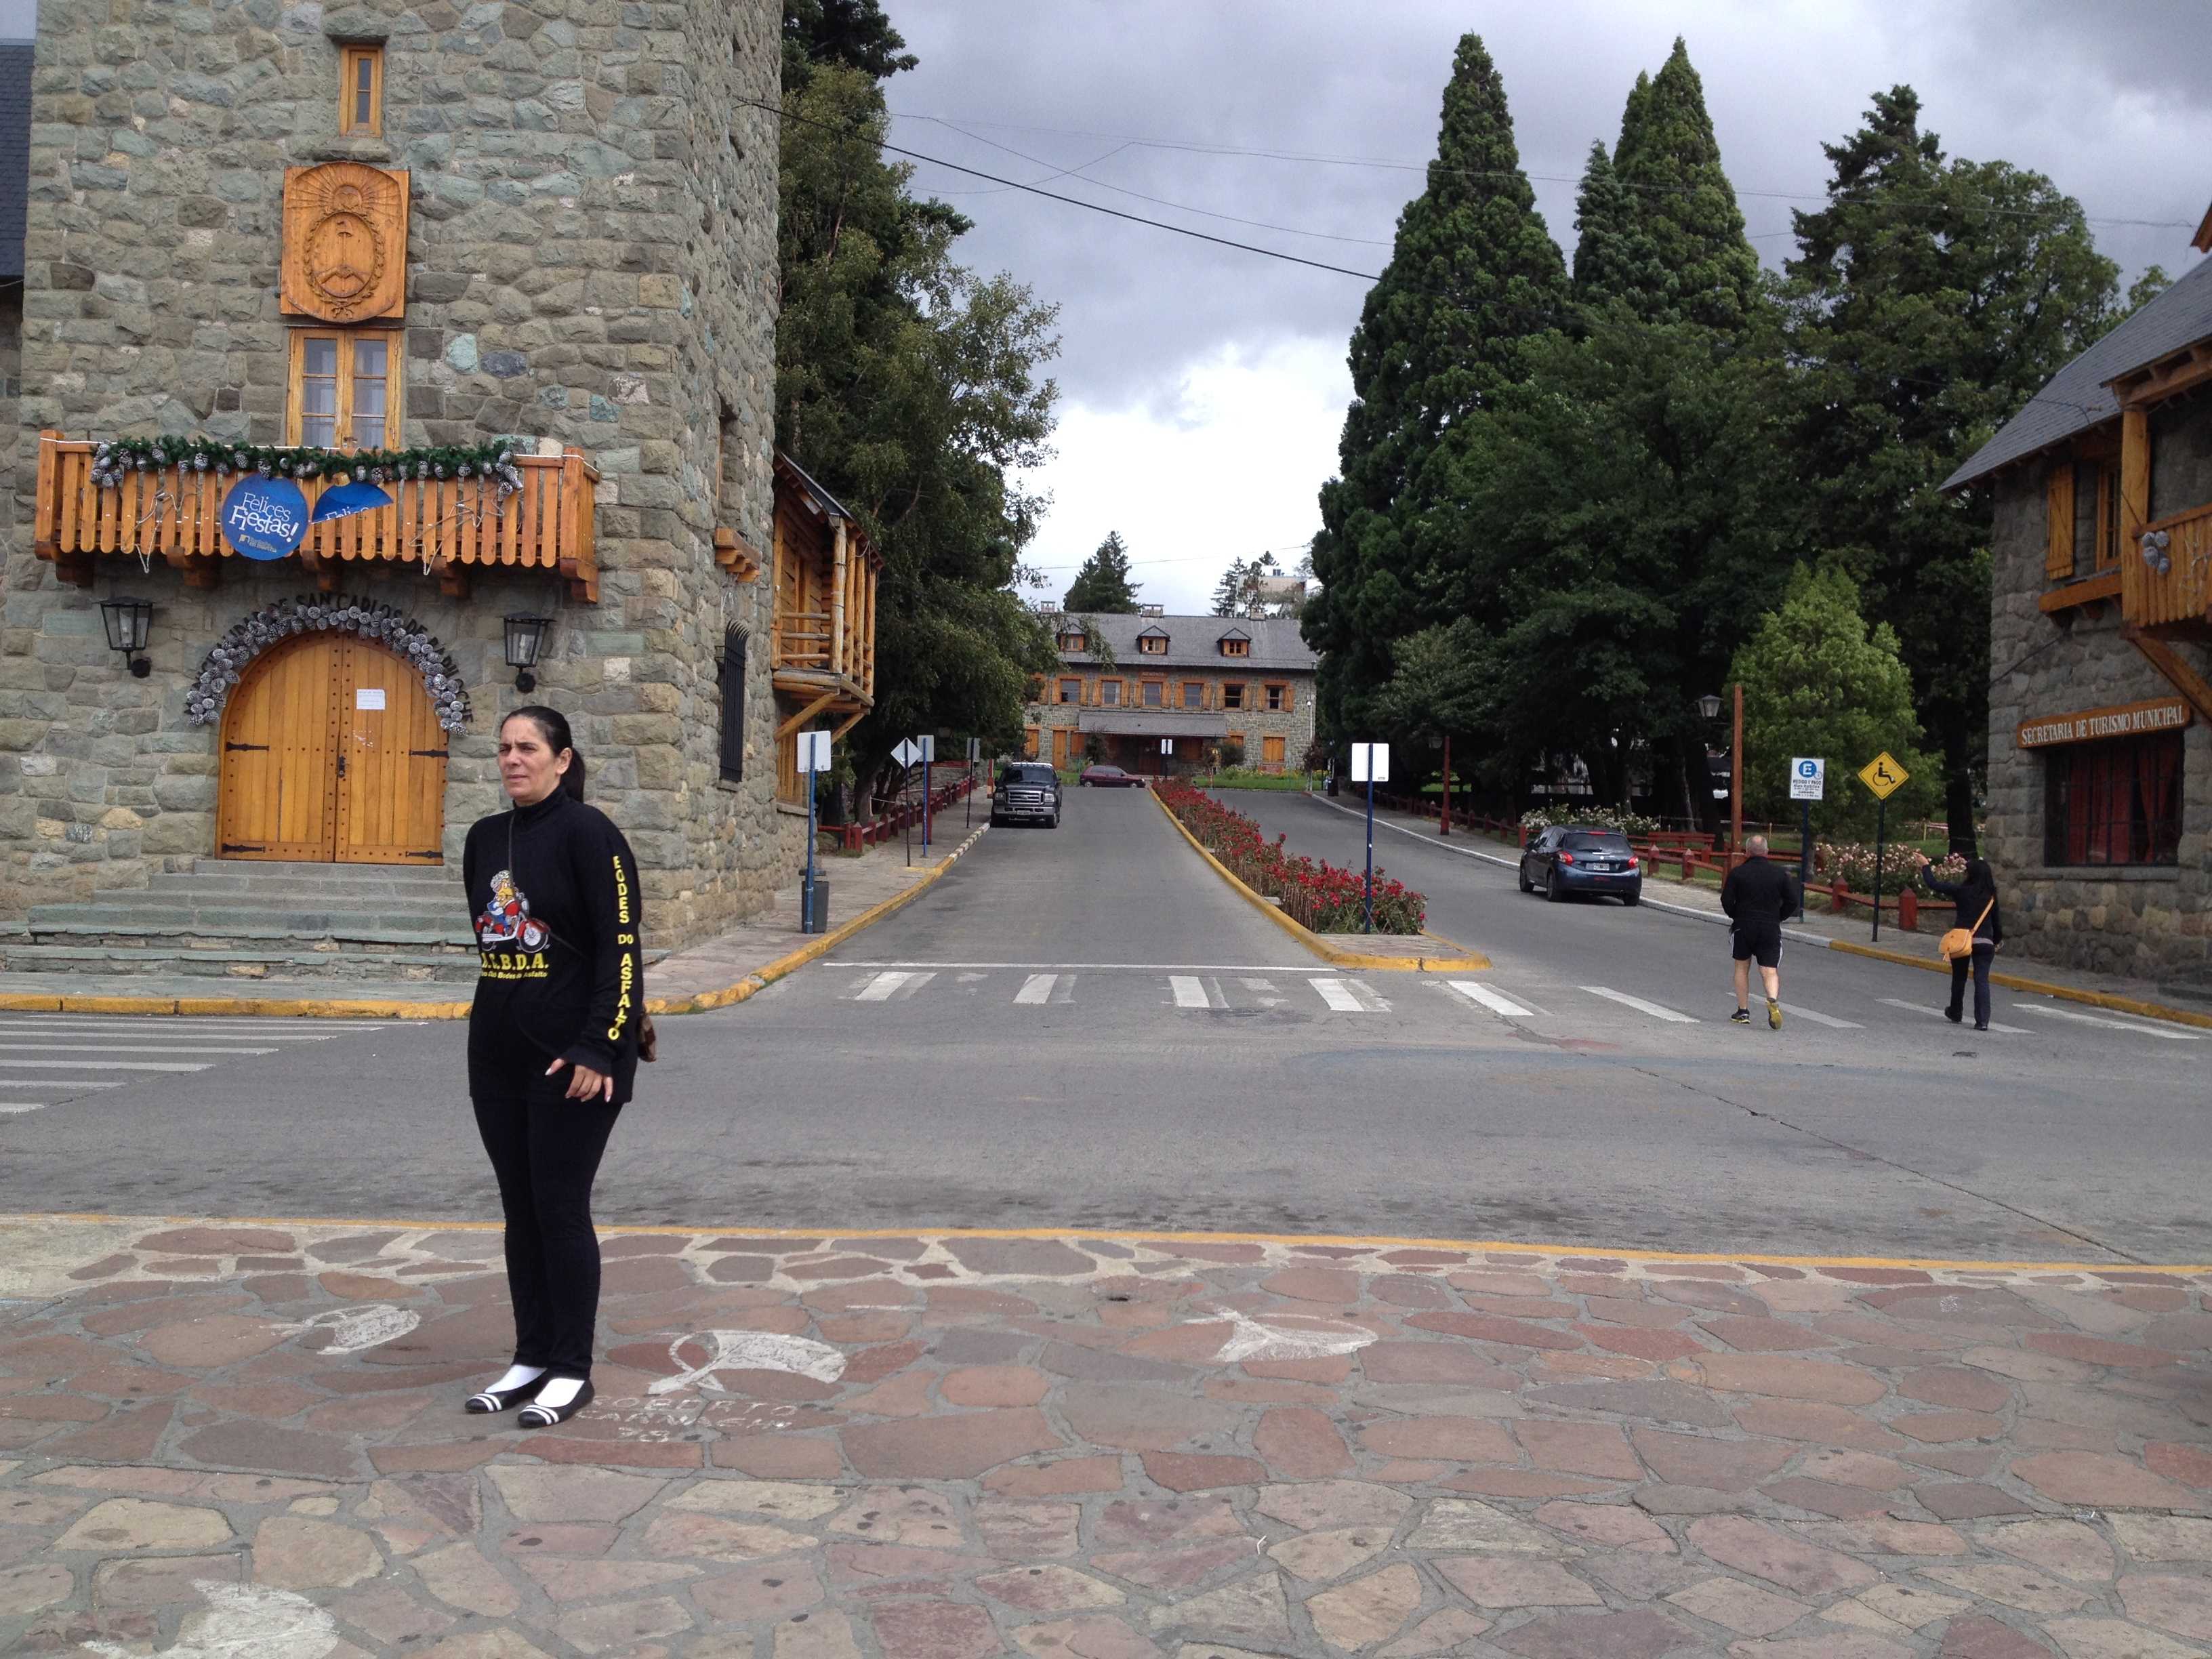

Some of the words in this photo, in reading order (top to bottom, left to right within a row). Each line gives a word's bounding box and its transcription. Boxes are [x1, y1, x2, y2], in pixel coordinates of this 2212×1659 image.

[243, 492, 291, 522] Felices
[2022, 722, 2074, 745] SECRETARIA
[2076, 720, 2087, 737] DE
[2089, 714, 2131, 736] TURISMO
[2133, 705, 2185, 729] MUNICIPAL
[1803, 763, 1813, 775] E
[618, 934, 634, 945] DO
[608, 953, 633, 1040] ASFALTO
